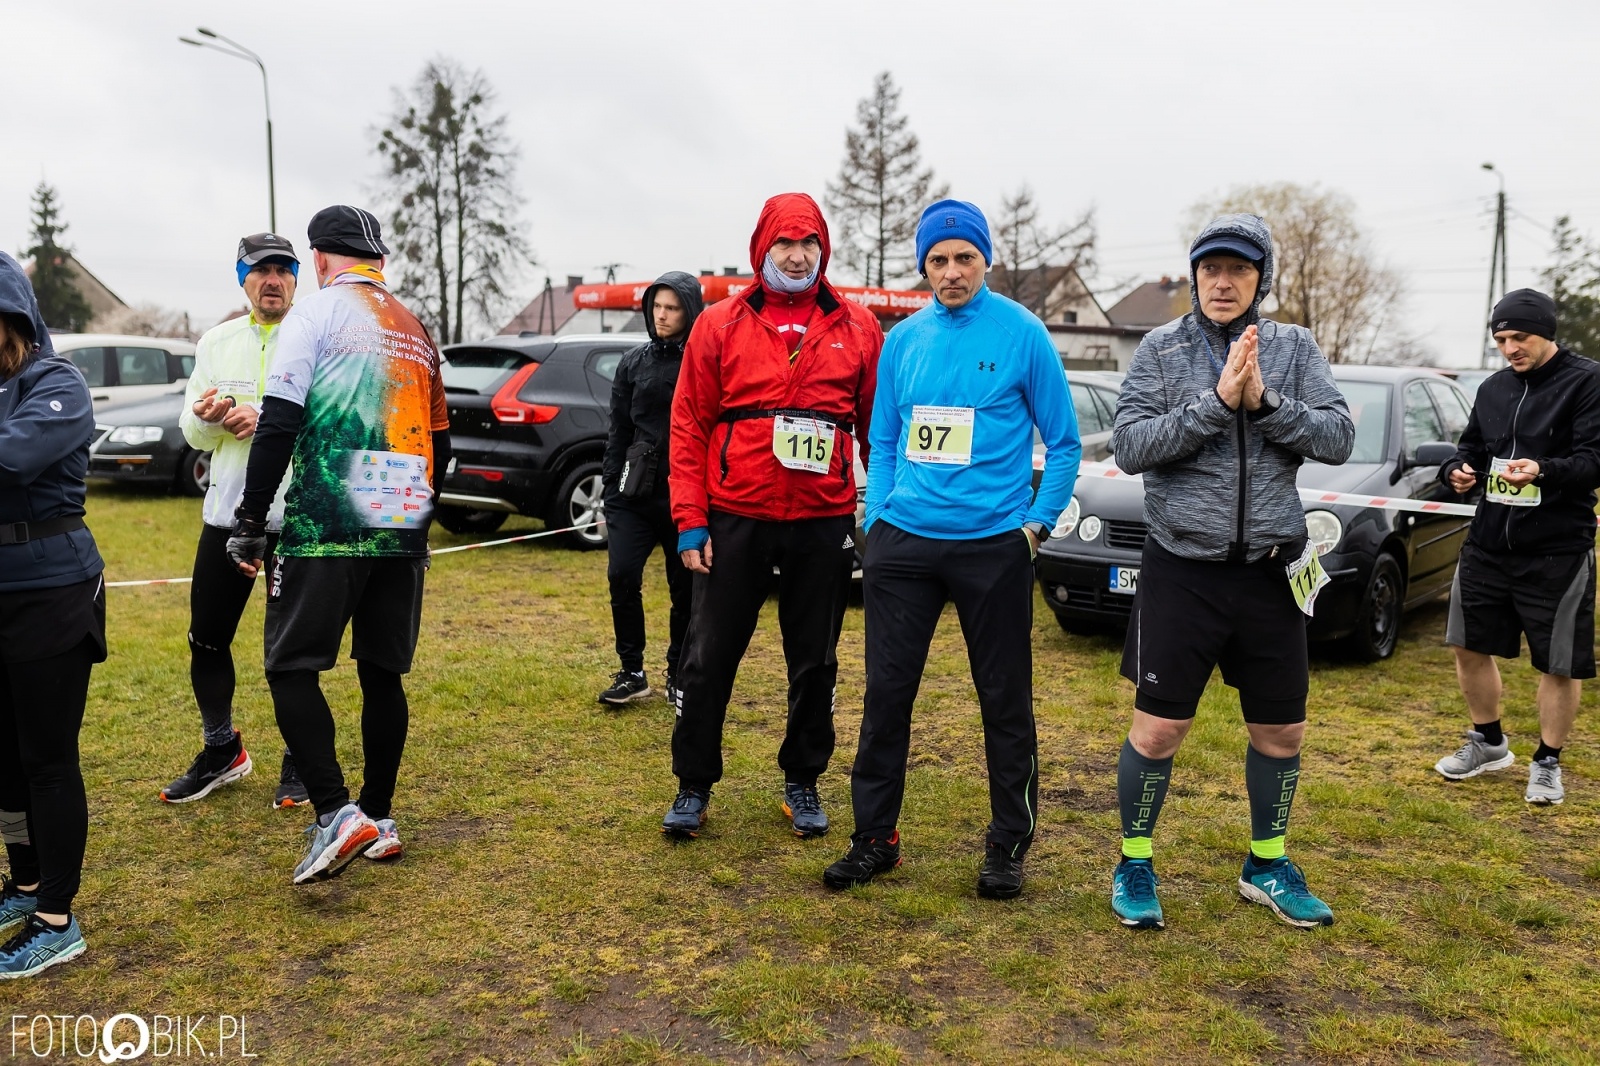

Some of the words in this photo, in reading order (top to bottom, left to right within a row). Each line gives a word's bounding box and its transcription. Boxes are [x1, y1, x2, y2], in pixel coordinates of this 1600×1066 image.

[391, 340, 411, 350] TEMU
[788, 435, 826, 462] 115
[918, 425, 952, 451] 97
[619, 460, 630, 492] adidas
